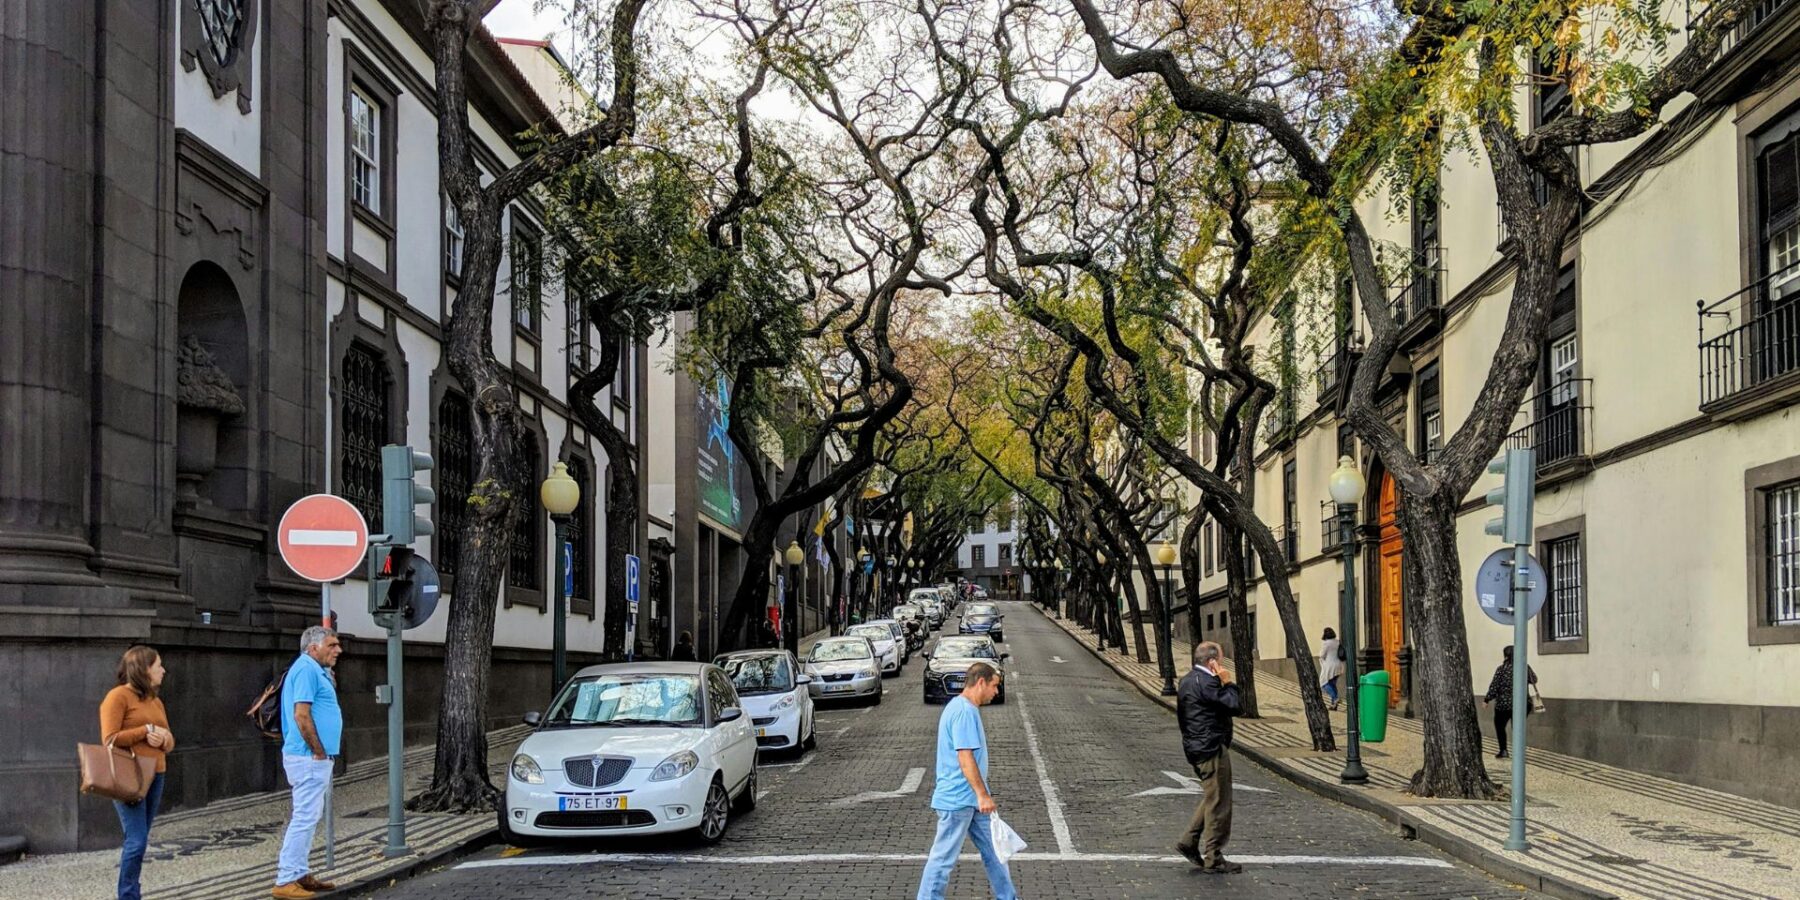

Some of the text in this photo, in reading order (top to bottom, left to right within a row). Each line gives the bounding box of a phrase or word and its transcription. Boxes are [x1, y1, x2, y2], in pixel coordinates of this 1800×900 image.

[630, 560, 637, 598] P
[567, 798, 619, 808] 75 ET 97
